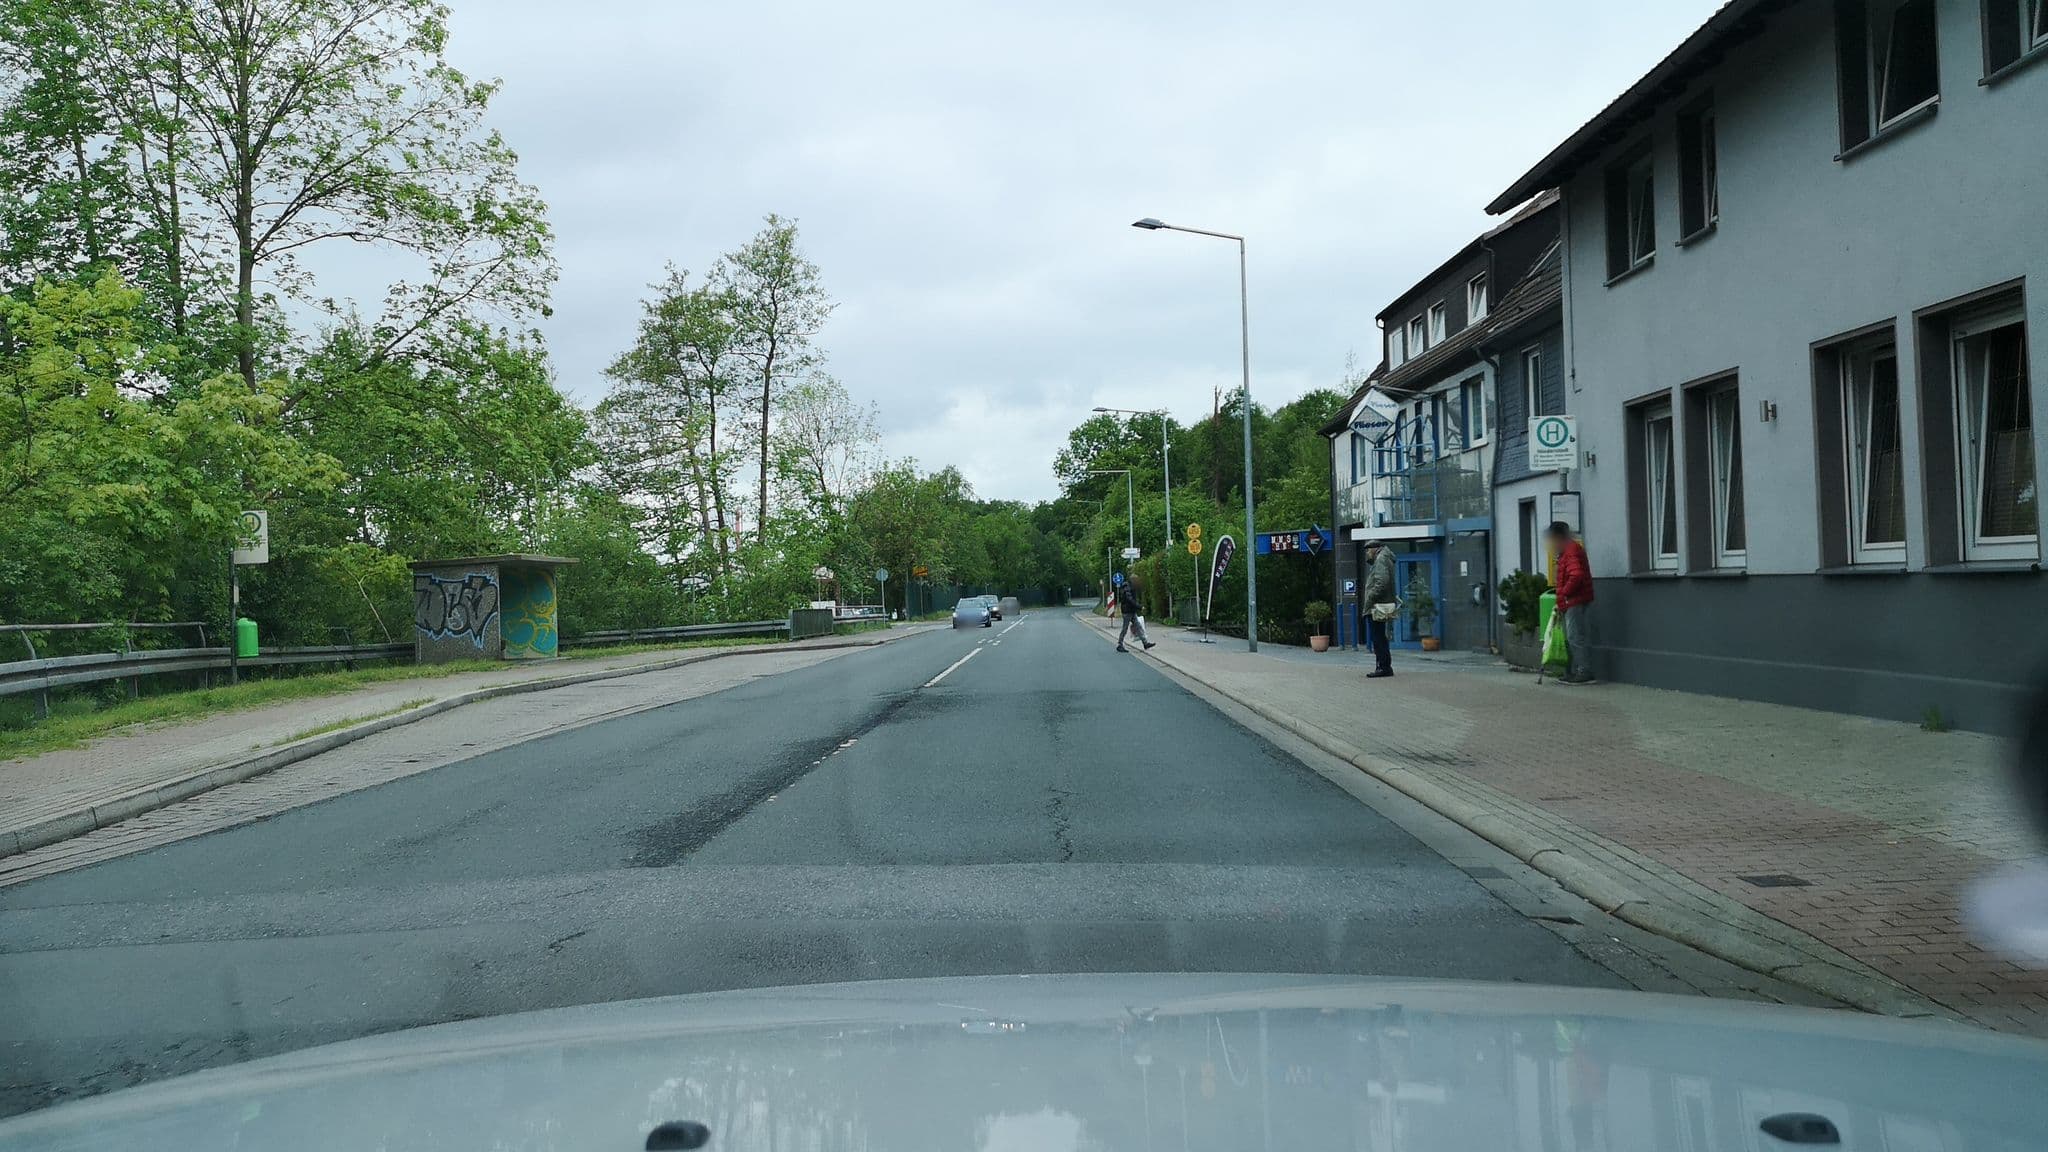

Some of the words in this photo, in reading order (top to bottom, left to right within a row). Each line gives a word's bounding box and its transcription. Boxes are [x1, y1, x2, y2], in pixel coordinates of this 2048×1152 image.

[1546, 423, 1559, 441] H
[1569, 435, 1576, 443] b
[1345, 581, 1354, 590] P
